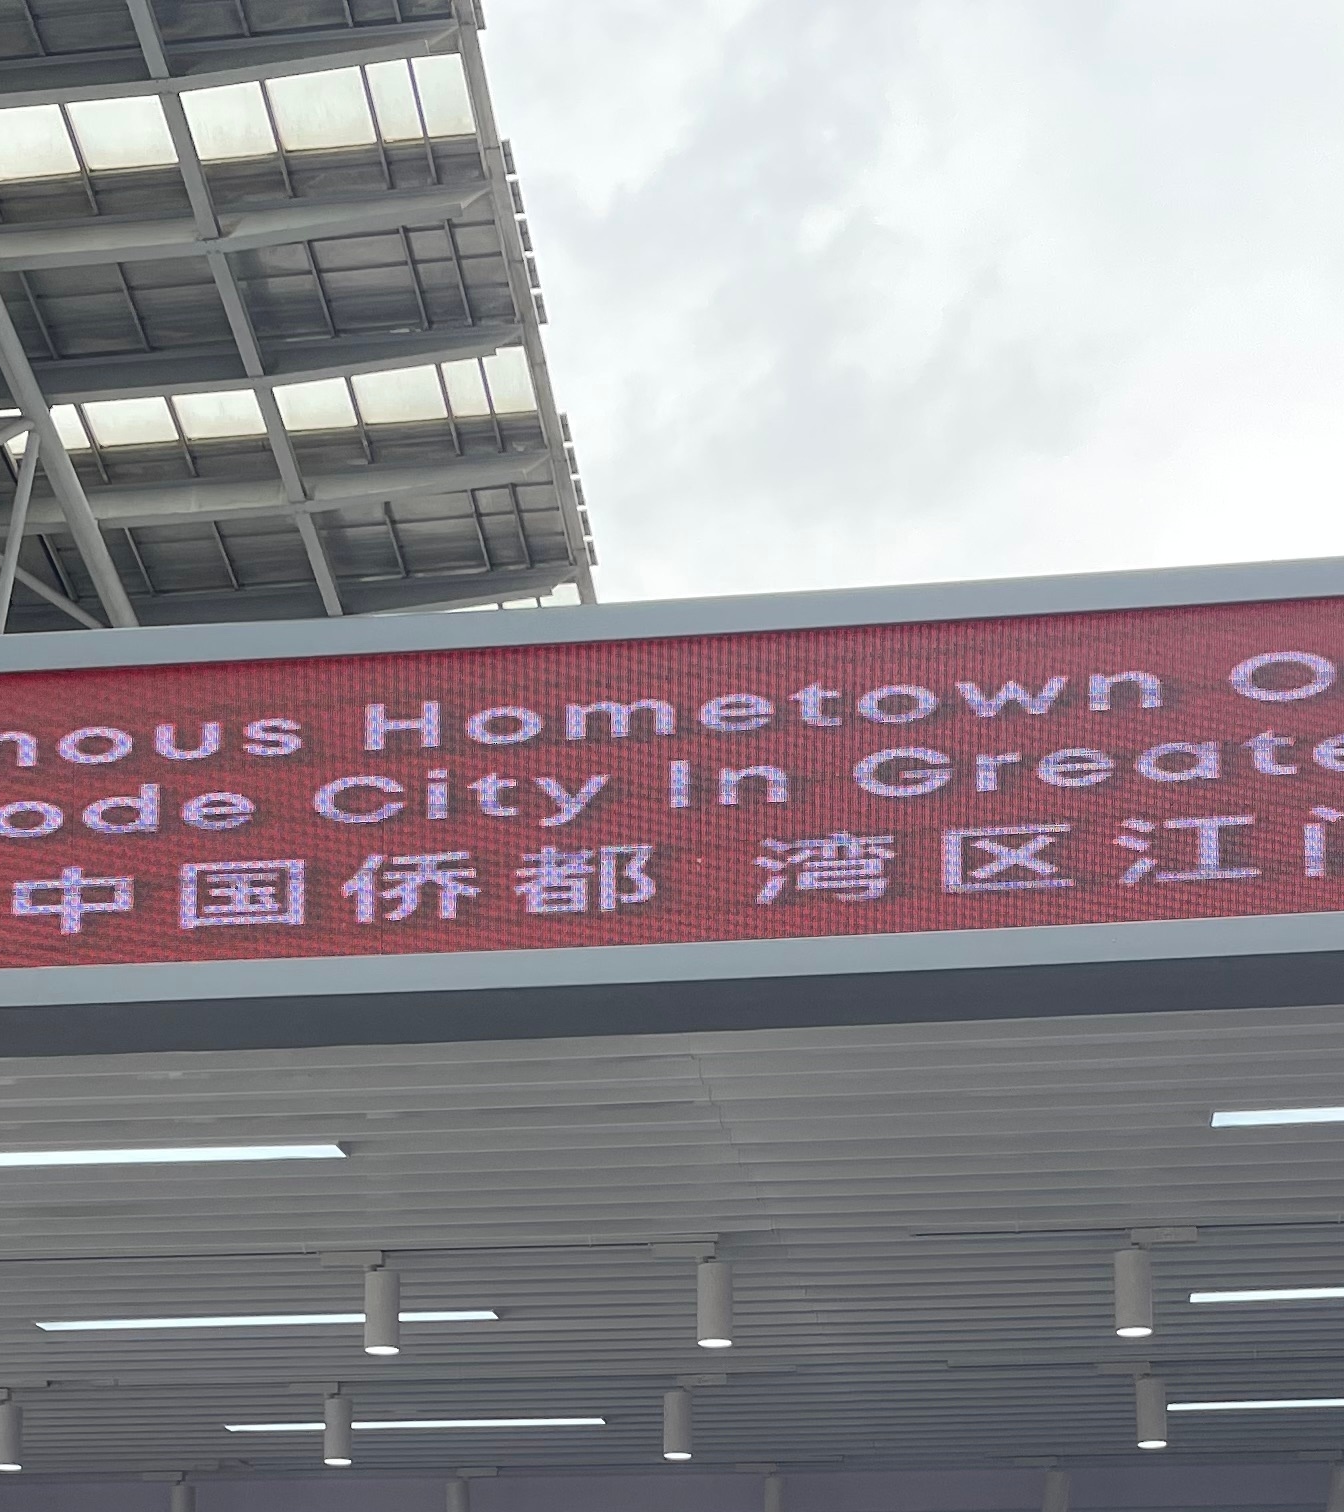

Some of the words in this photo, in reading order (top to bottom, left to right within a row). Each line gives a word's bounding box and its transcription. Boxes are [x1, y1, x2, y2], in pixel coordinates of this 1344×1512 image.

[364, 670, 1164, 751] Hometown
[314, 768, 610, 827] City
[668, 759, 791, 809] In
[10, 843, 656, 935] 中国侨都
